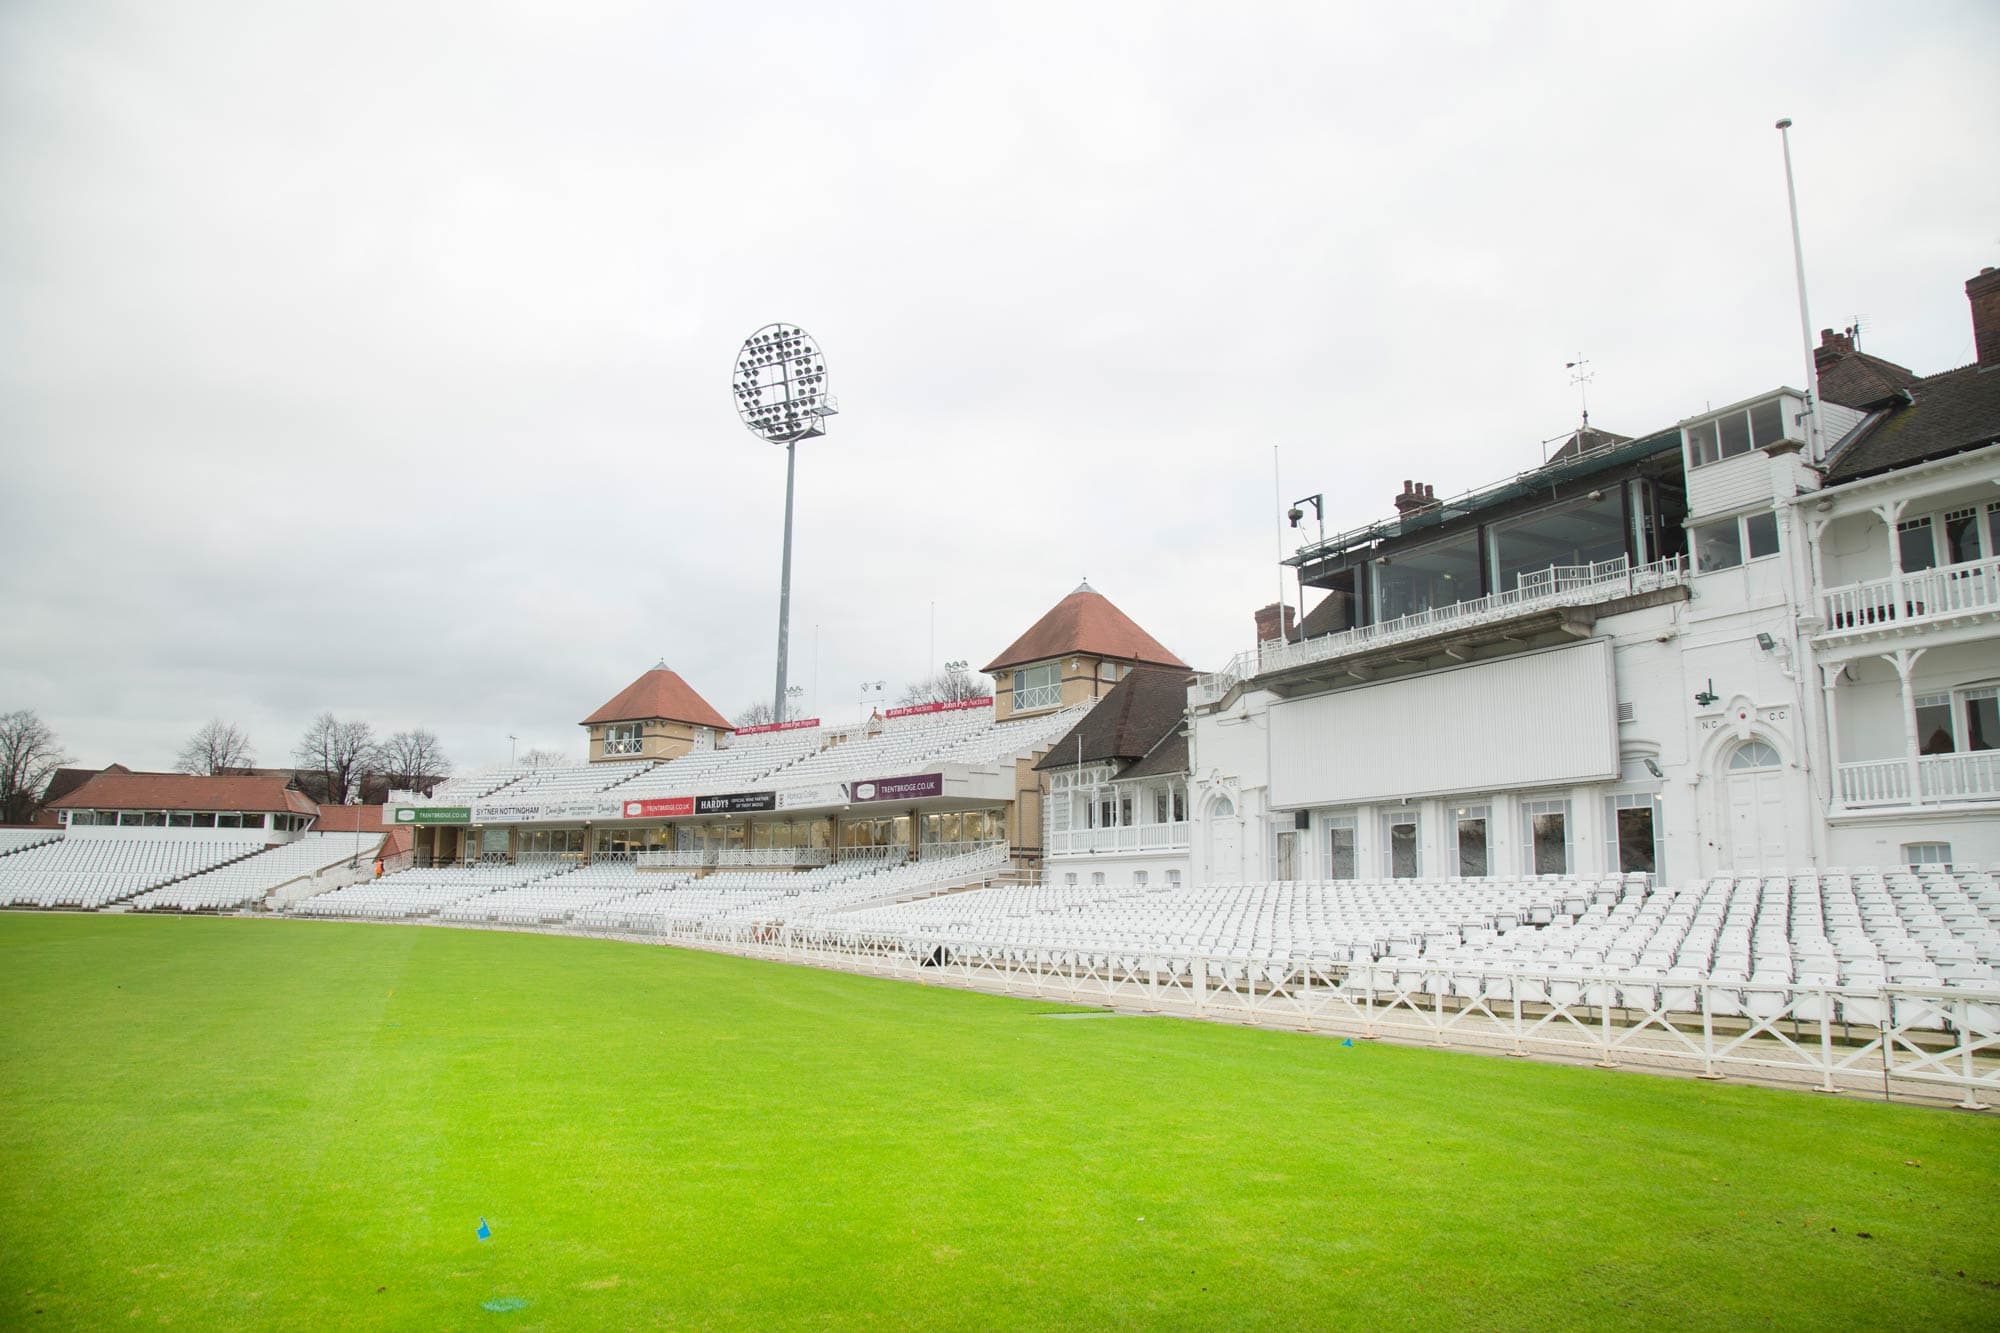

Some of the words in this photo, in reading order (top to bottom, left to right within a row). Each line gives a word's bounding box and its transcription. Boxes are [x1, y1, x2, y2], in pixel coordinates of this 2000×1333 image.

[957, 700, 967, 708] Pye
[881, 782, 935, 793] TRENTBRIDGE.CO.UK
[476, 807, 499, 816] SYTNER
[500, 806, 540, 815] NOTTINGHAM
